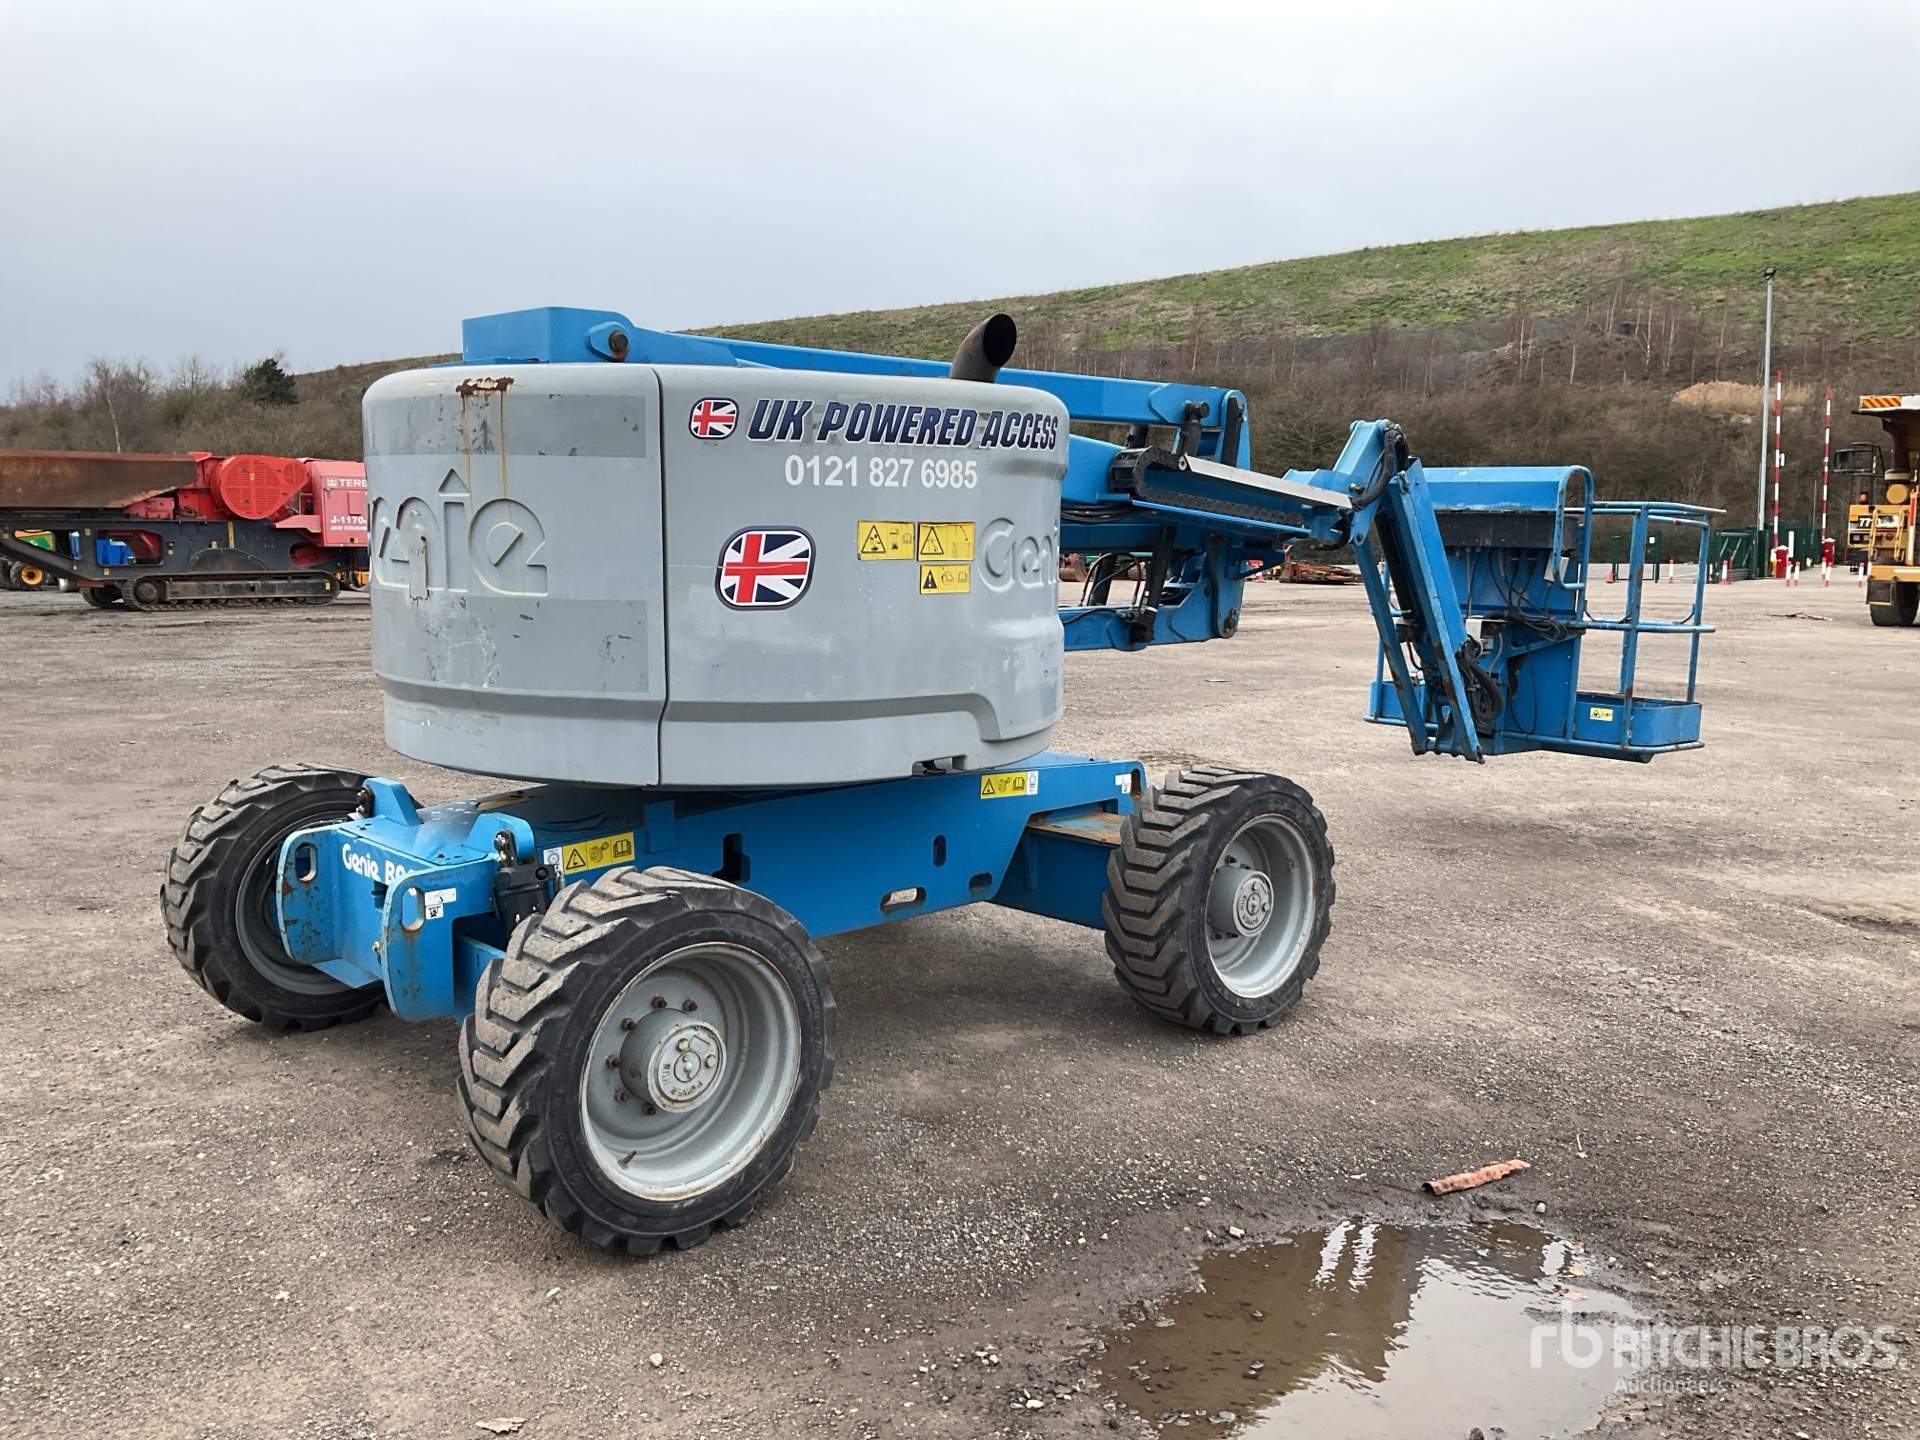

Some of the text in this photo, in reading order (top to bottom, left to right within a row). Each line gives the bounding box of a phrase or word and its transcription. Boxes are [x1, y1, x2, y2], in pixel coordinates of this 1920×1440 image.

[746, 398, 1058, 450] UK POWERED ACCESS
[785, 455, 977, 489] 0121 827 6985
[342, 843, 382, 882] Genie
